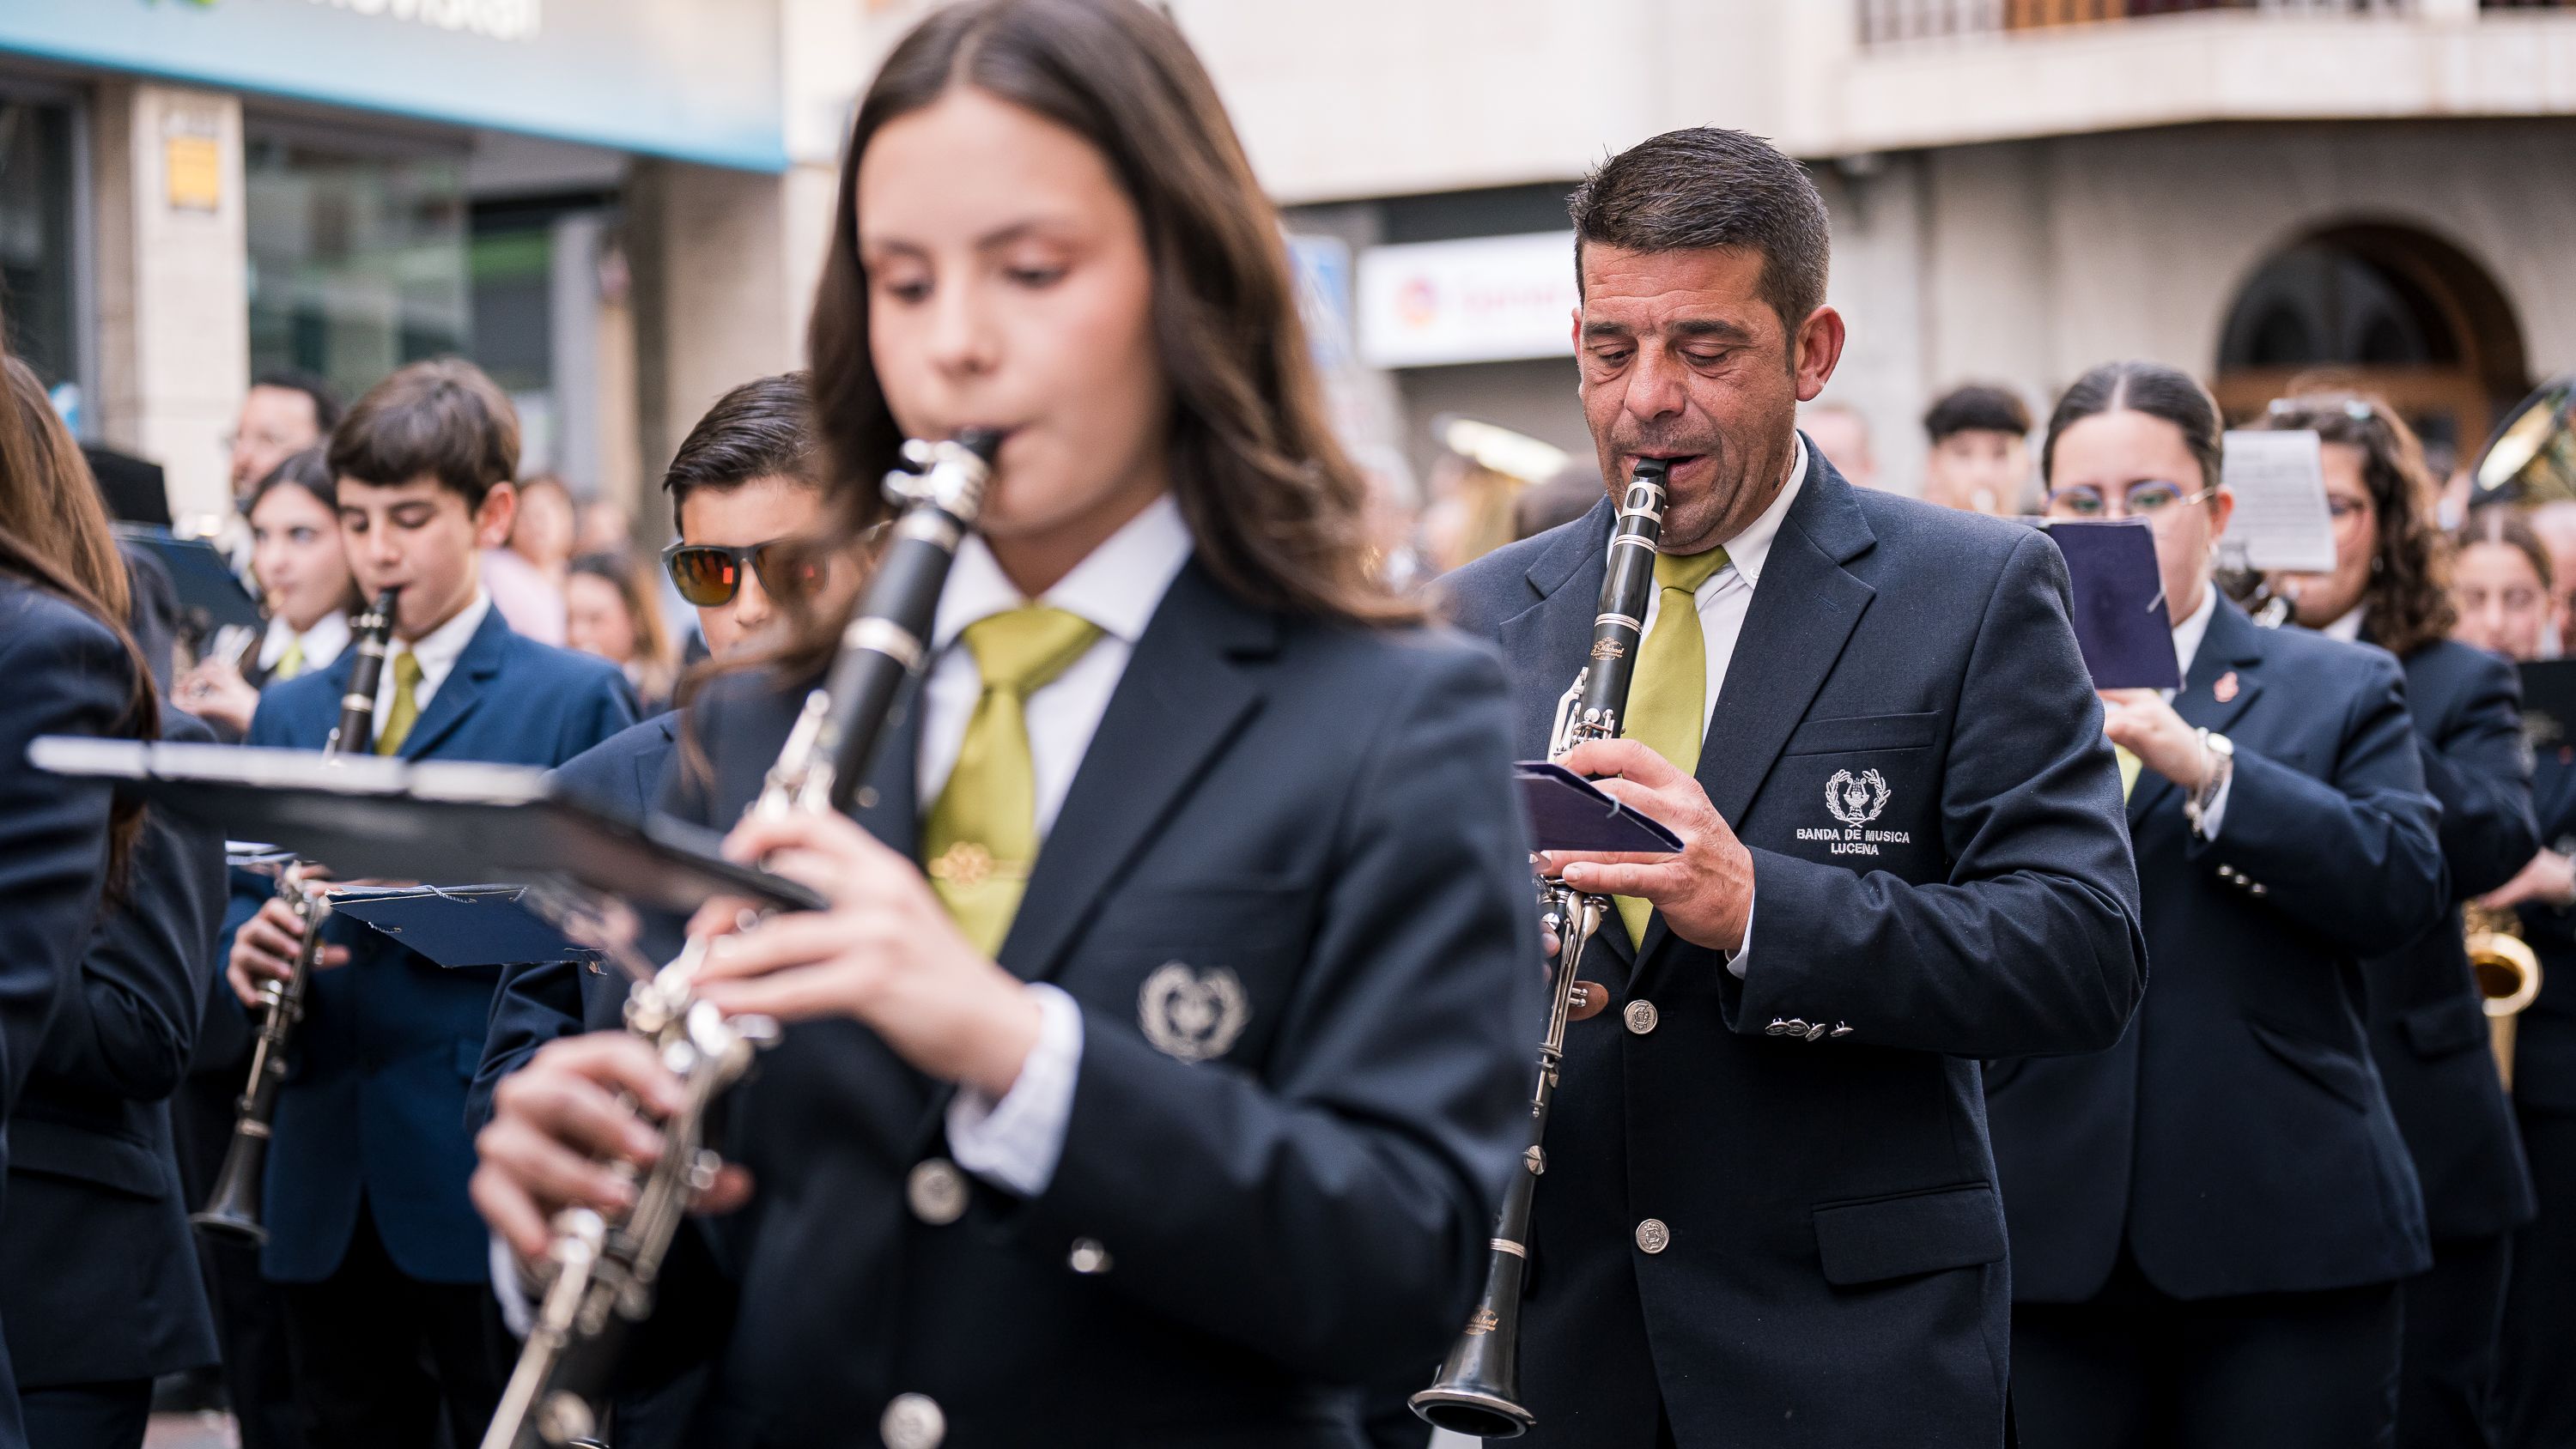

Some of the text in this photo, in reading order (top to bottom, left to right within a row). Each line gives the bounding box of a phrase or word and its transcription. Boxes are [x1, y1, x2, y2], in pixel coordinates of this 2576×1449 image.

[1796, 828, 1910, 843] BANDA DE MUSICA
[1831, 843, 1879, 855] LUCENA
